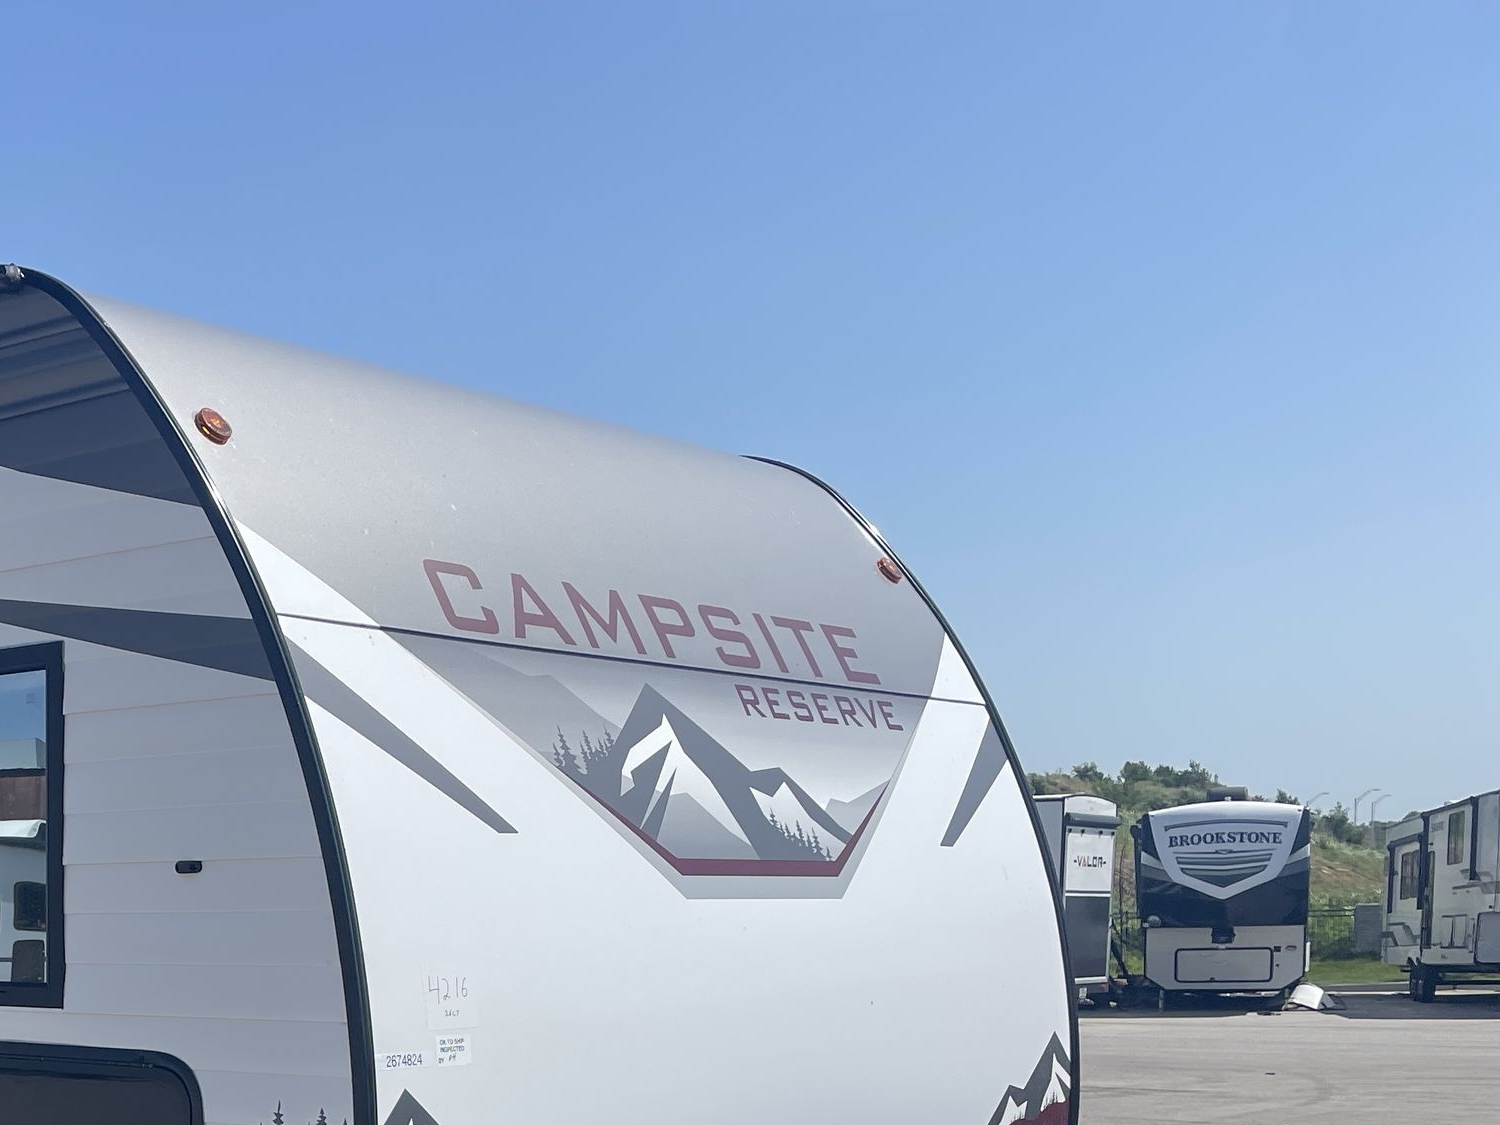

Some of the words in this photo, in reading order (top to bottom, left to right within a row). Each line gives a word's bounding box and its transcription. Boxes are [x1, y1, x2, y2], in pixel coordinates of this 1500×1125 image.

[423, 558, 882, 685] CAMPSITE
[734, 683, 904, 732] RESERVE
[1168, 831, 1283, 848] BROOKSTONE
[427, 975, 468, 1005] 4216
[386, 1053, 423, 1068] 2674824
